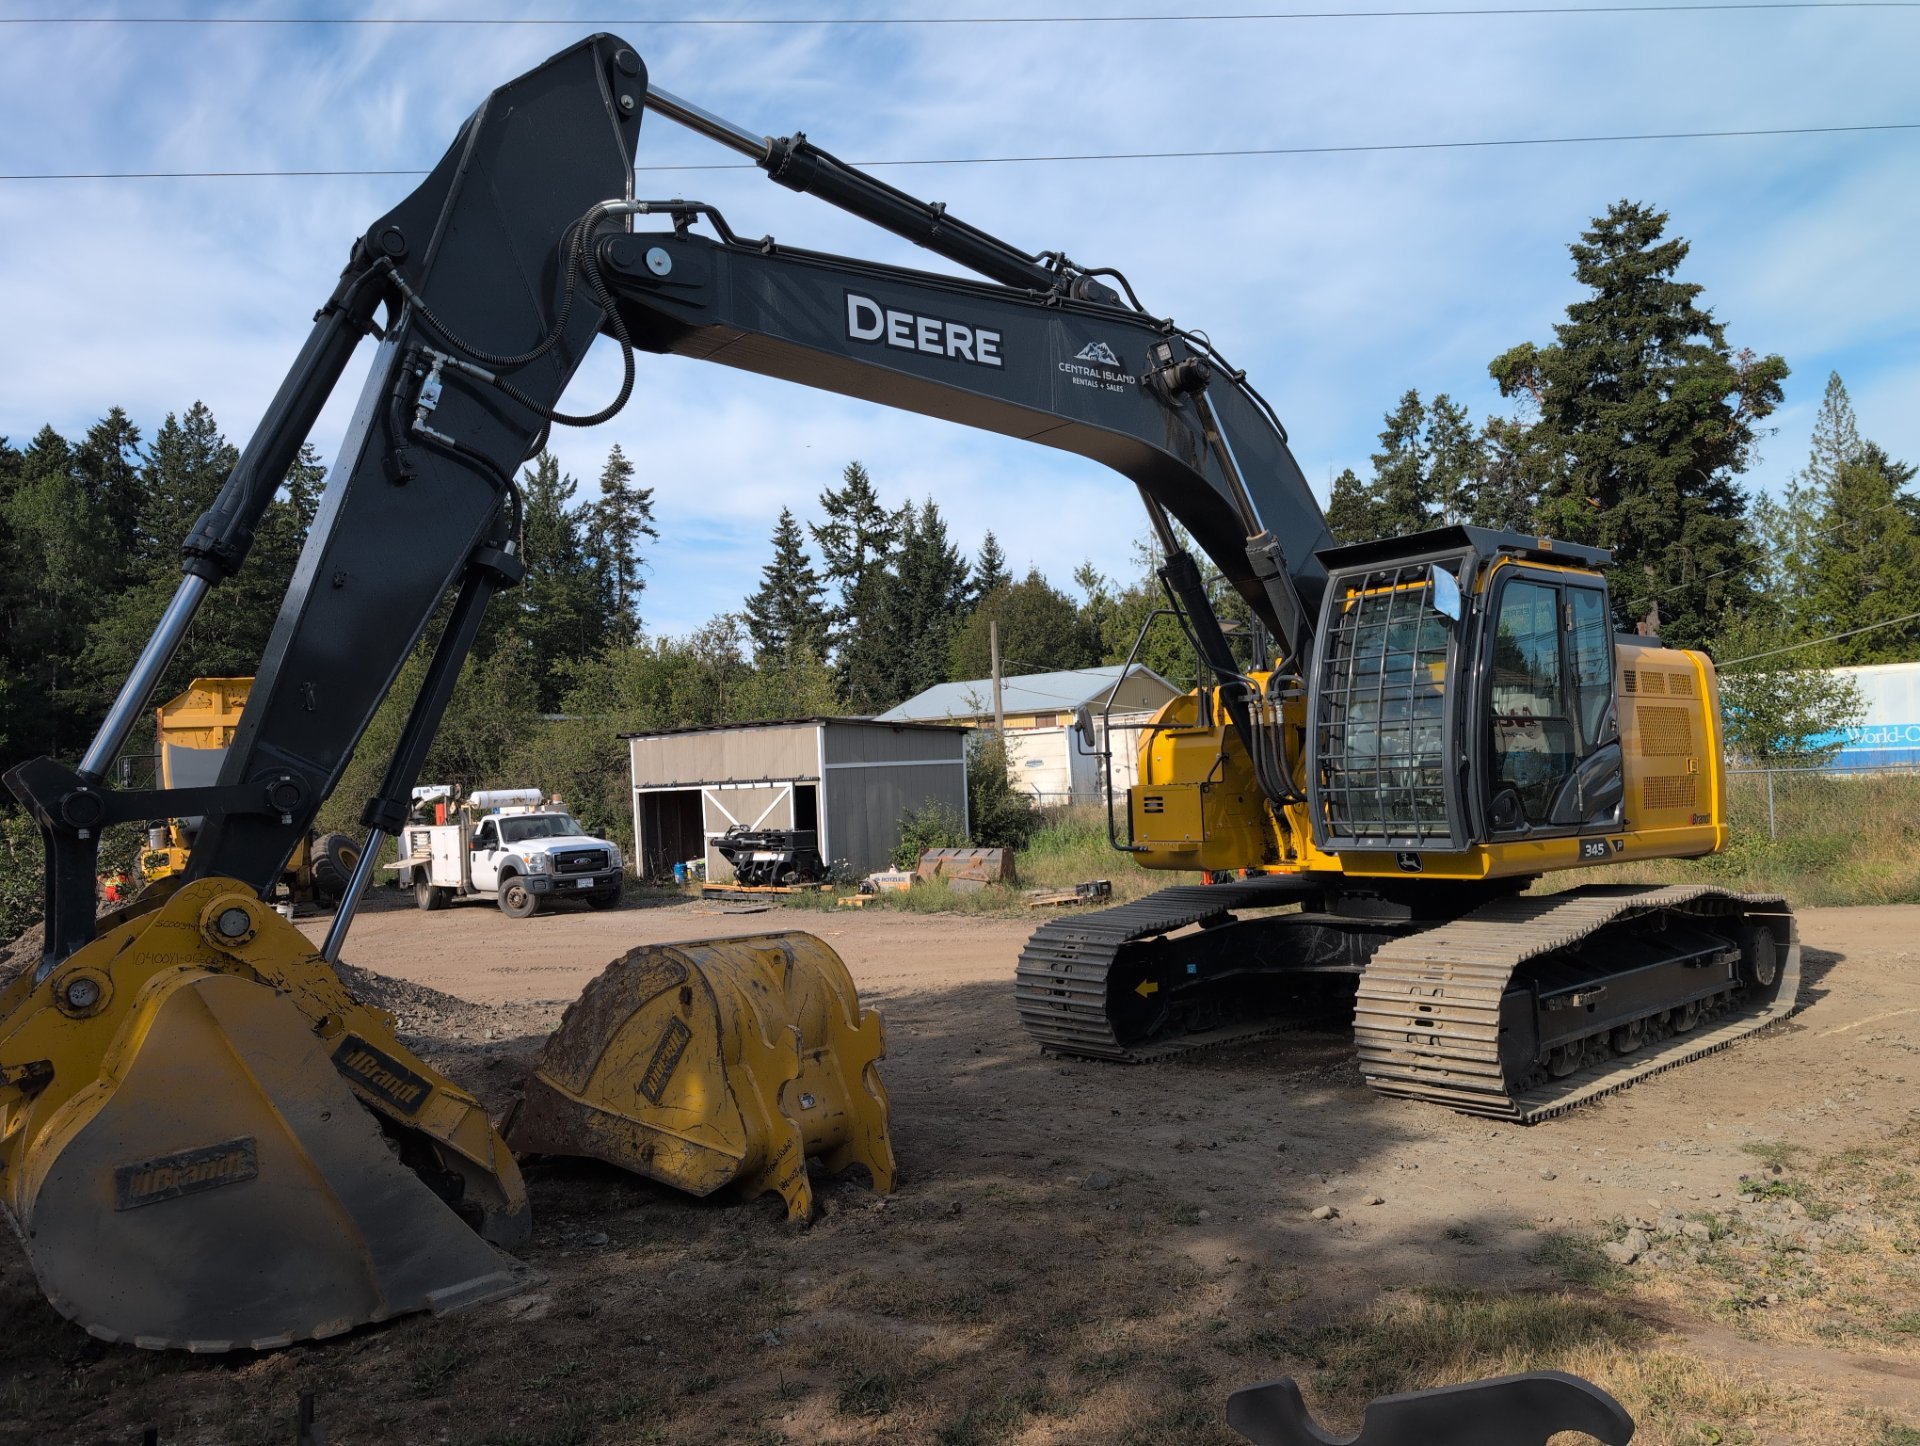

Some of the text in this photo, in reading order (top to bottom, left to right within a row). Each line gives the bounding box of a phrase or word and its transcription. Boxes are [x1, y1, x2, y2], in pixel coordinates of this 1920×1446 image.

[847, 294, 1002, 366] DEERE
[1058, 362, 1136, 385] CENTRAL ISLAND
[1072, 377, 1098, 388] RENTALS
[1106, 383, 1124, 393] SALES
[1585, 841, 1623, 857] 345 P
[354, 1053, 420, 1103] Brandt
